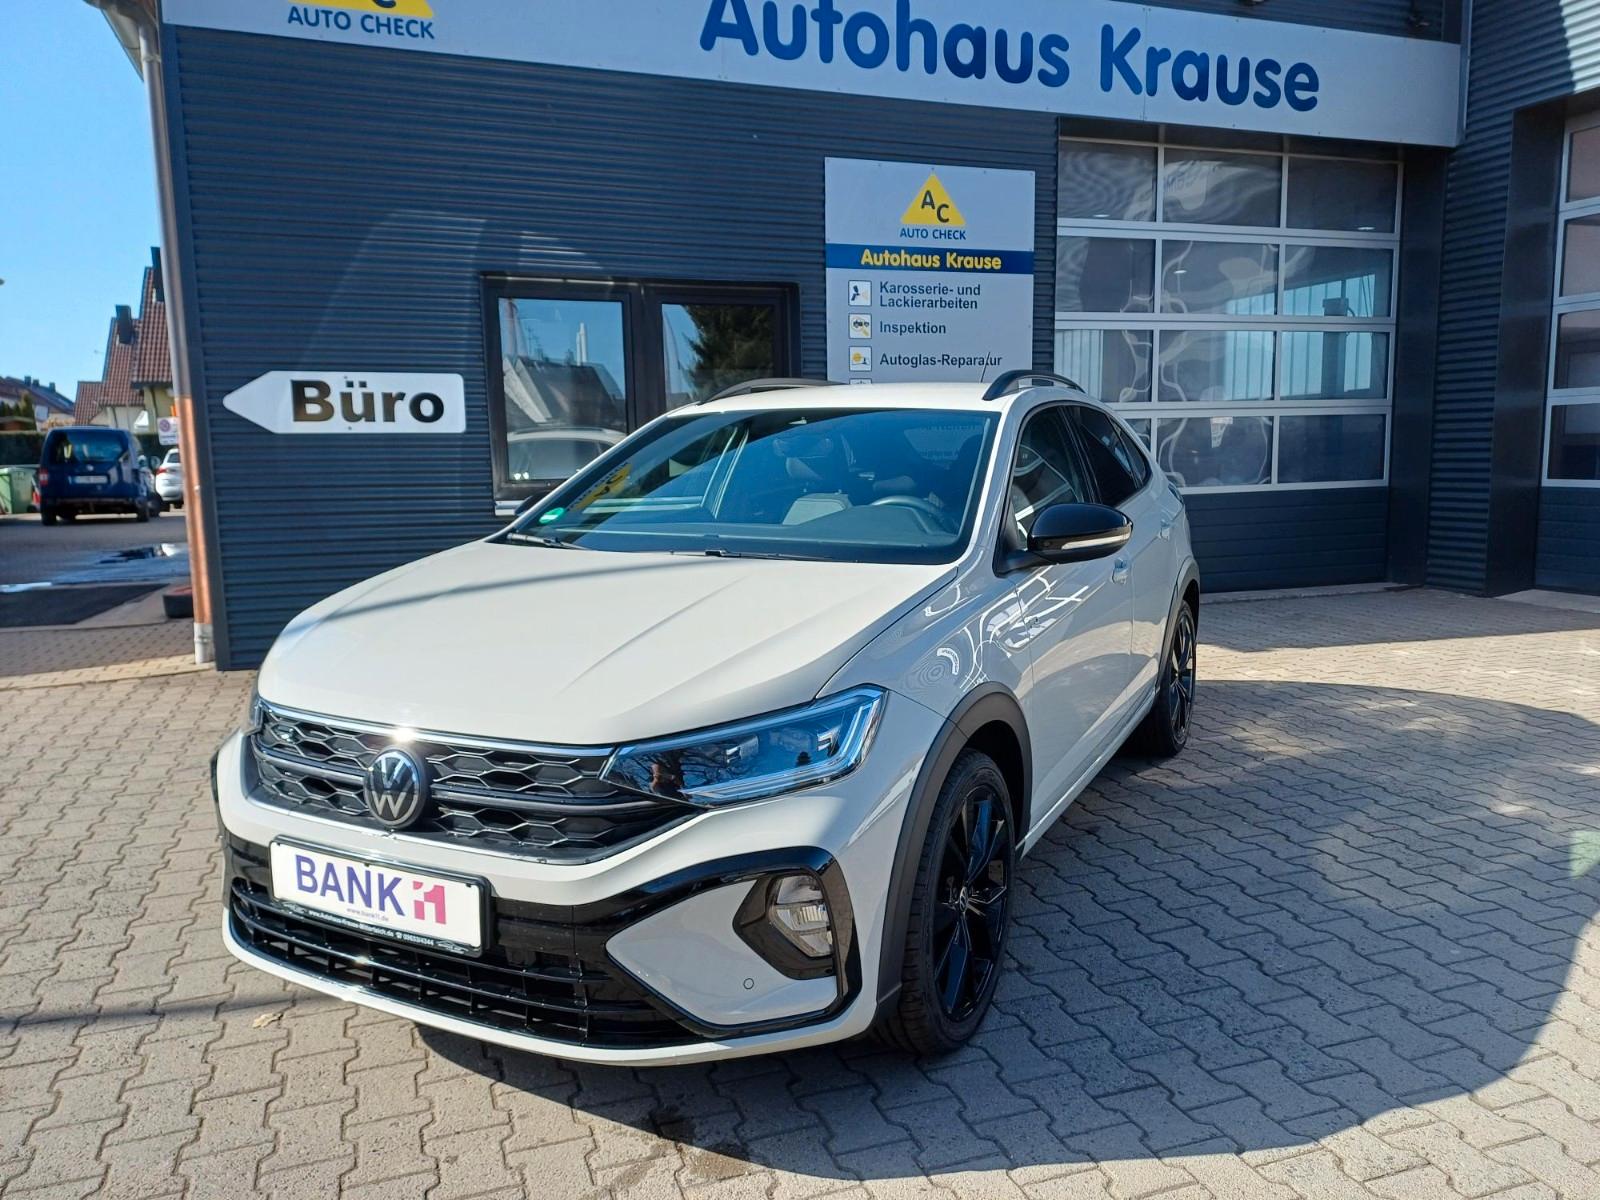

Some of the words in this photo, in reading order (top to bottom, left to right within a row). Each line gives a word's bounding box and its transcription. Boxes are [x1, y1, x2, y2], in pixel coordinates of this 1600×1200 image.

[287, 6, 351, 31] AUTO
[360, 14, 435, 40] CHECK
[700, 0, 1070, 88] Autohaus
[1100, 23, 1320, 111] Krause
[899, 227, 929, 240] AUTO
[932, 229, 967, 241] CHECK
[861, 248, 941, 268] Autohaus
[946, 252, 1002, 270] Krause
[879, 281, 954, 296] Karosserie-
[957, 284, 981, 296] und
[879, 295, 978, 310] Lackierarbeiten
[879, 320, 947, 336] Inspektion
[290, 379, 445, 424] Büro
